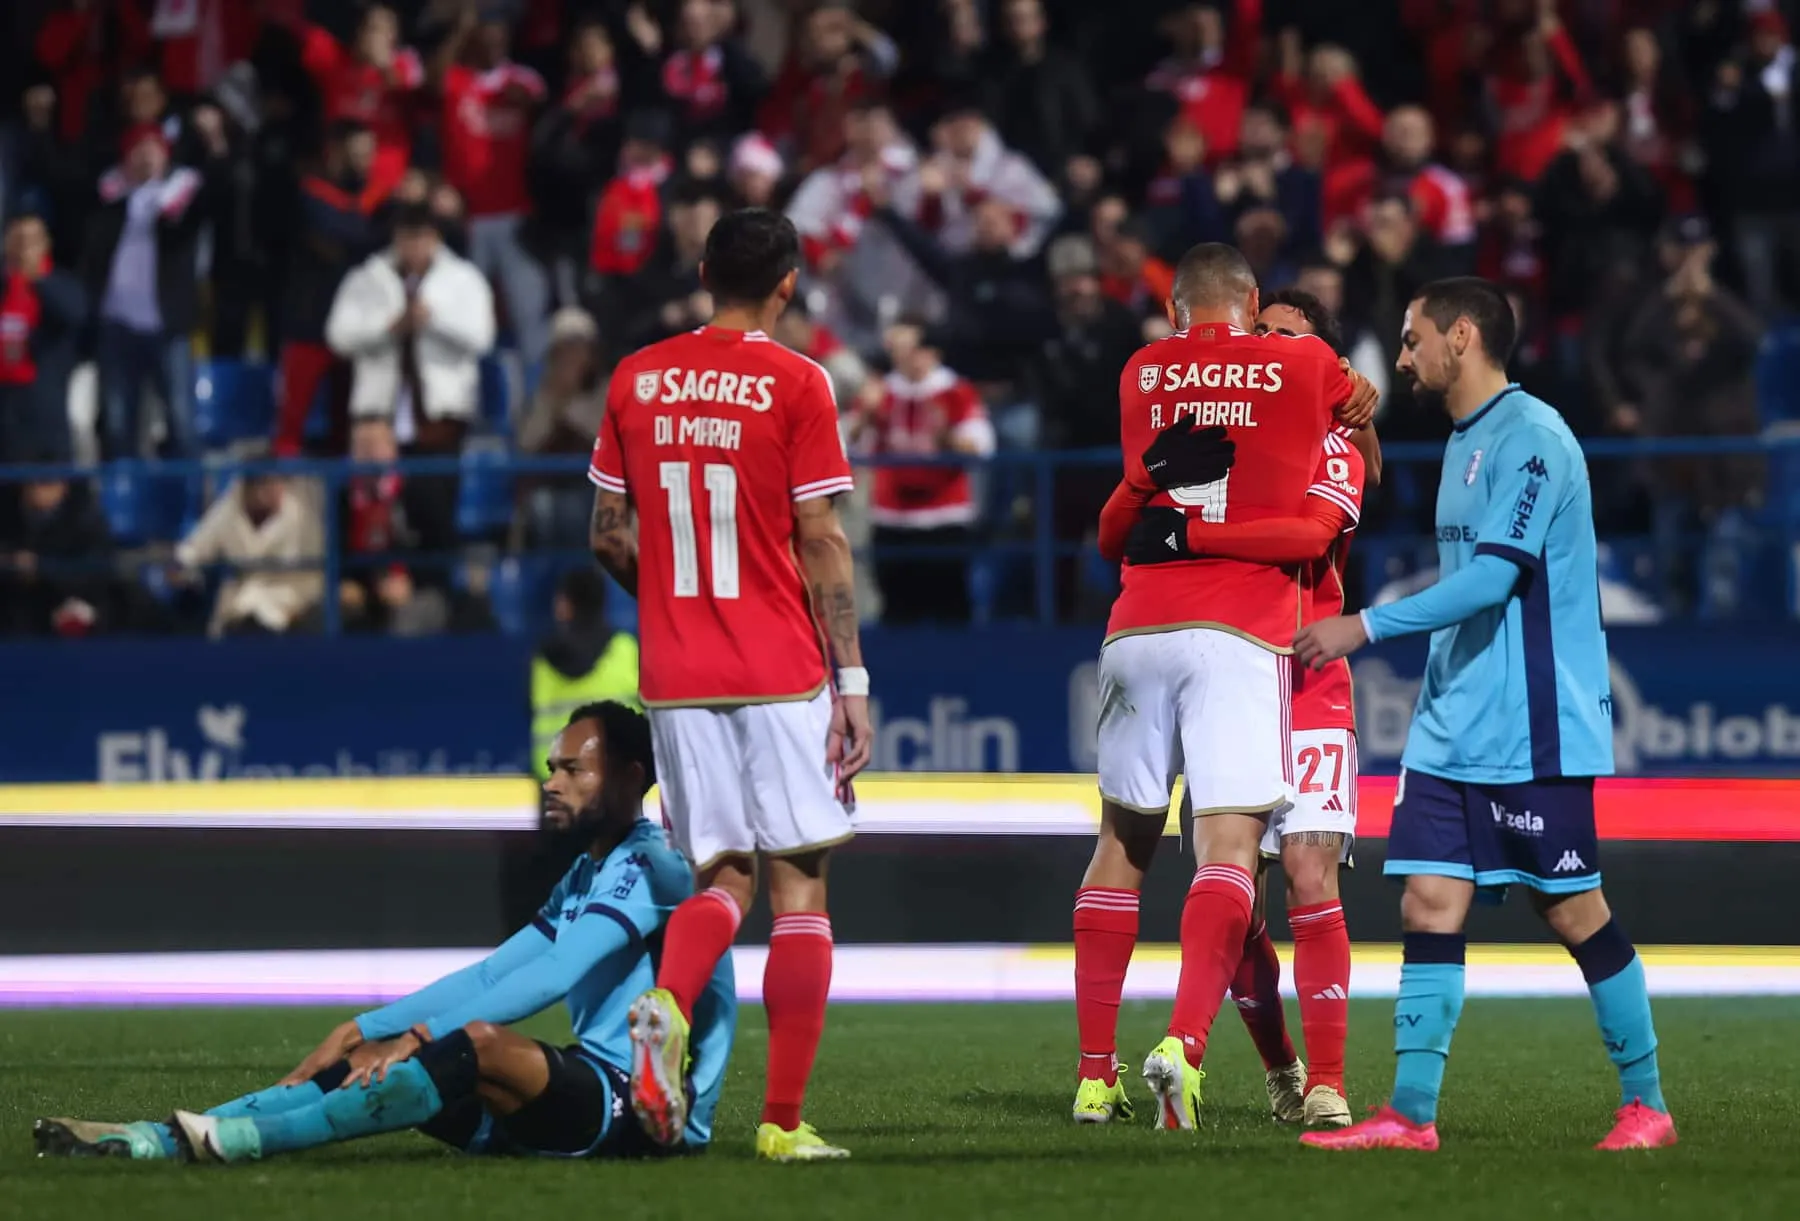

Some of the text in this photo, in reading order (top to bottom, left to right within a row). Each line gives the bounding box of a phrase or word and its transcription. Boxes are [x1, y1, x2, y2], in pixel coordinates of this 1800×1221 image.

[660, 367, 776, 412] SAGRES
[1163, 362, 1283, 393] SAGRES
[654, 415, 742, 452] DI MARIA
[1151, 403, 1166, 430] A.
[659, 461, 741, 600] 11
[1297, 743, 1344, 793] 27
